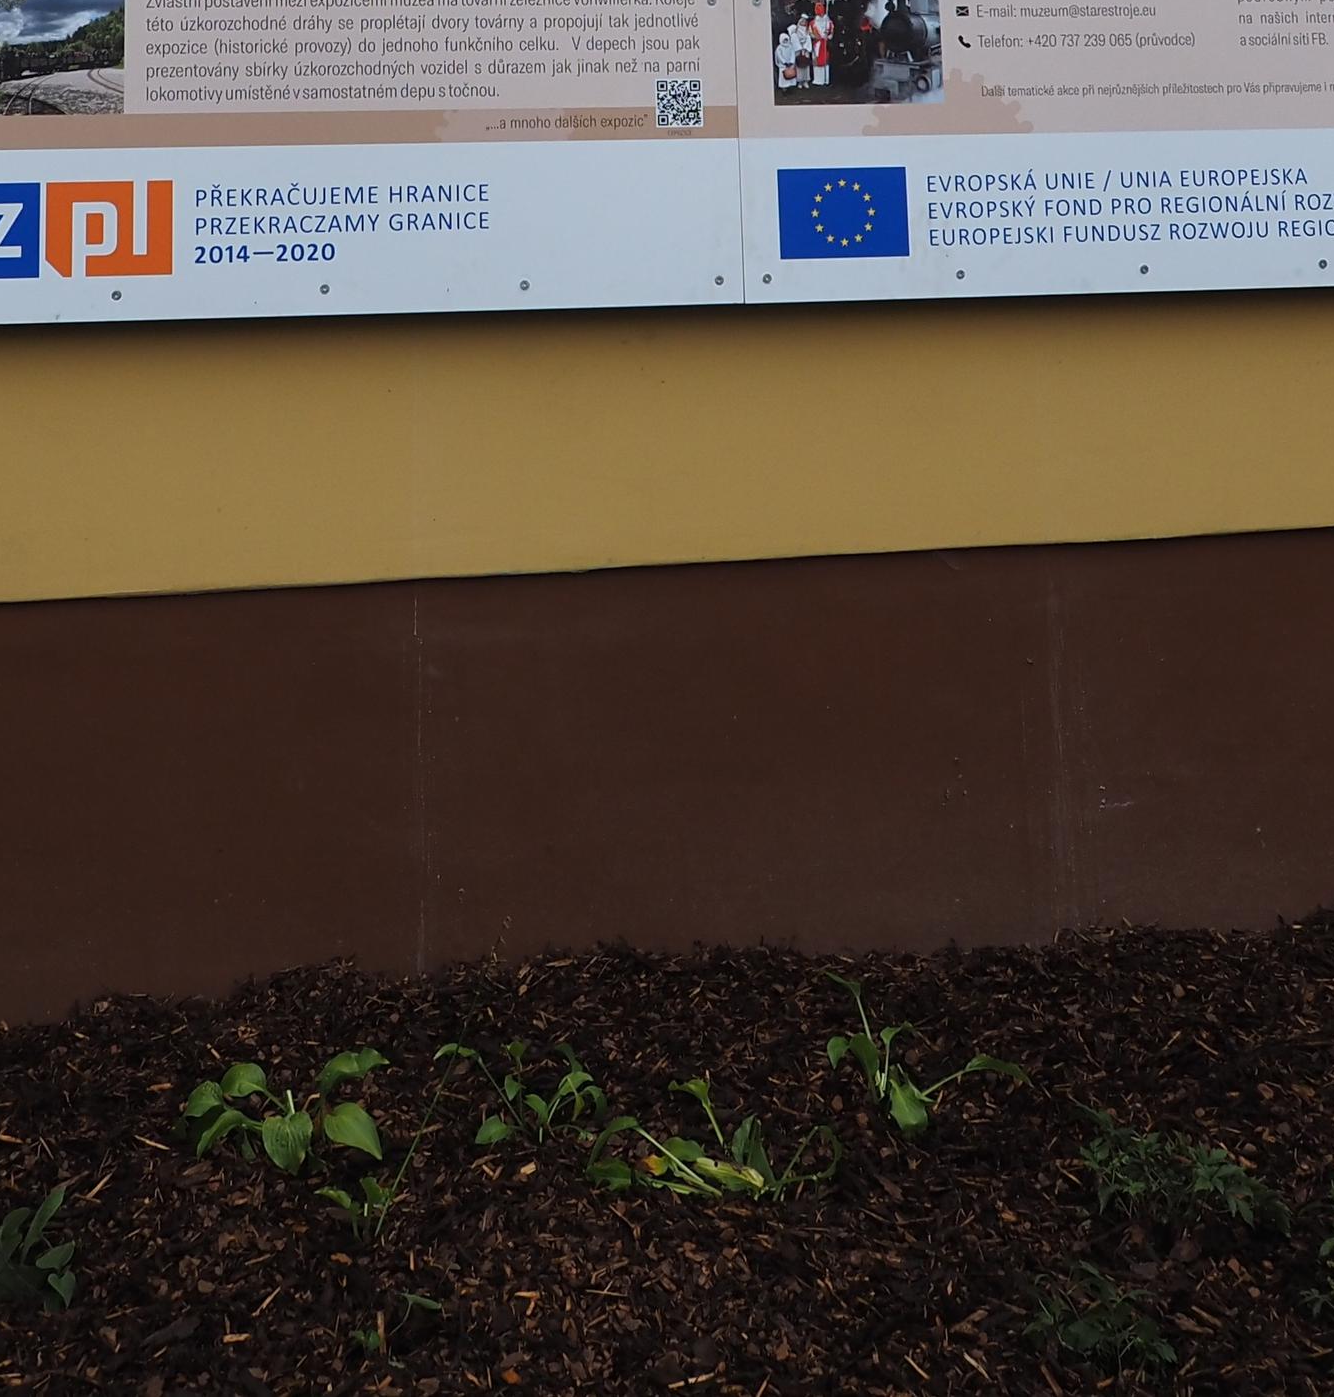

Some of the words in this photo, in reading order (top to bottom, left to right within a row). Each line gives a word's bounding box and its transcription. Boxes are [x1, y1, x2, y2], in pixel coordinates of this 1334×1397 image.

[927, 169, 1036, 192] EVROPSKÁ
[1045, 172, 1095, 189] UNIE
[1120, 171, 1171, 188] UNIA
[1180, 168, 1307, 186] EUROPEJSKA
[196, 183, 377, 207] PŘEKRAČUJEME
[389, 184, 488, 203] HRANICE
[928, 195, 1035, 219] EVROPSKÝ
[1045, 199, 1101, 216] FOND
[1111, 198, 1151, 214] PRO
[1161, 190, 1285, 213] REGIONÁLNÍ
[196, 214, 379, 235] PRZEKRACZAMY
[389, 212, 489, 231] GRANICE
[929, 226, 1053, 246] EUROPEJSKI
[1064, 224, 1161, 242] FUNDUSZ
[1170, 221, 1268, 239] ROZWOJU
